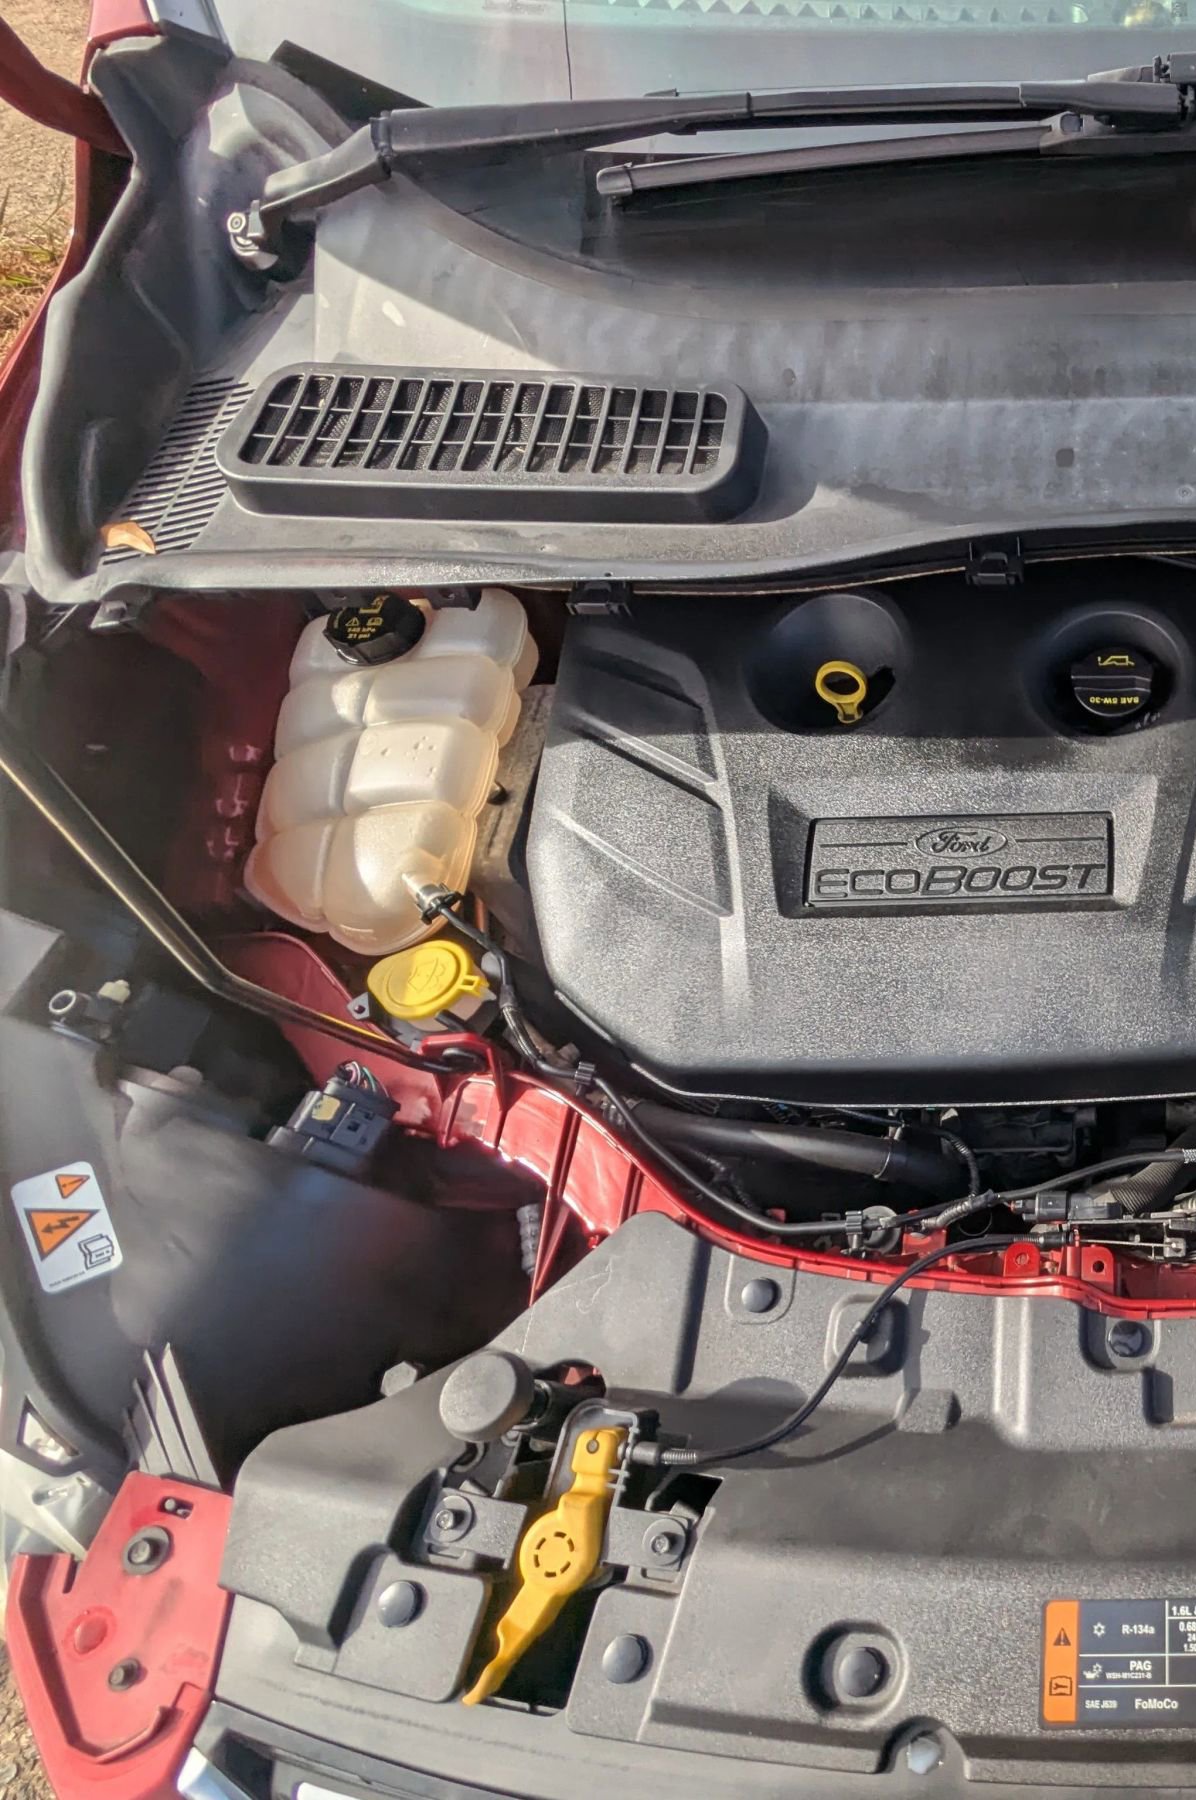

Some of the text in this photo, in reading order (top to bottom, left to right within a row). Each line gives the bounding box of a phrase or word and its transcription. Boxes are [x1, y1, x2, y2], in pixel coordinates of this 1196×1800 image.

[1089, 696, 1118, 704] 5W-30
[930, 830, 990, 853] Ford
[1172, 1606, 1192, 1616] 1.6L
[1121, 1624, 1155, 1634] R-134a
[1187, 1634, 1196, 1642] 24
[1129, 1660, 1152, 1671] PAG
[1085, 1700, 1100, 1709] SAE
[1134, 1698, 1179, 1710] FoMoCo
